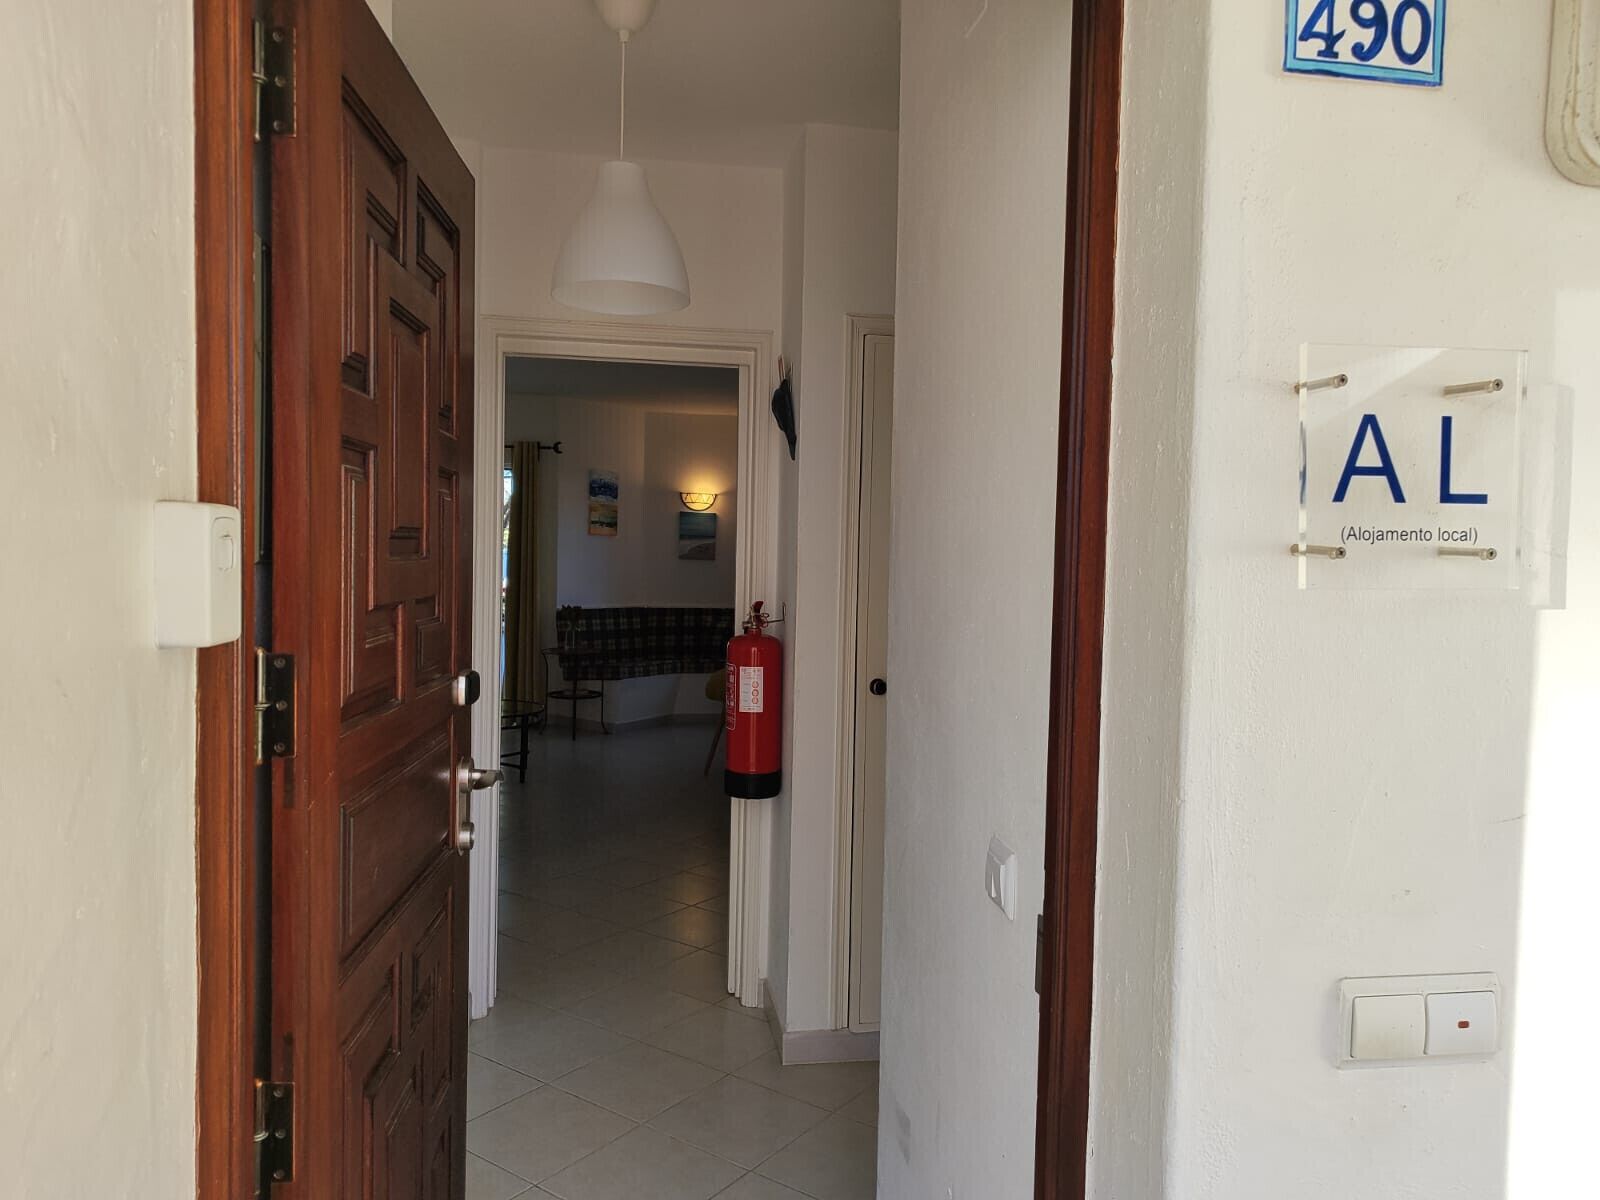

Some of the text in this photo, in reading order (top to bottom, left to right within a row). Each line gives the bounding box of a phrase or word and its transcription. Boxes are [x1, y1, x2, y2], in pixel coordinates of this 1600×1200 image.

[1298, 0, 1432, 66] 490
[1340, 525, 1478, 545] (Alojamento local)
